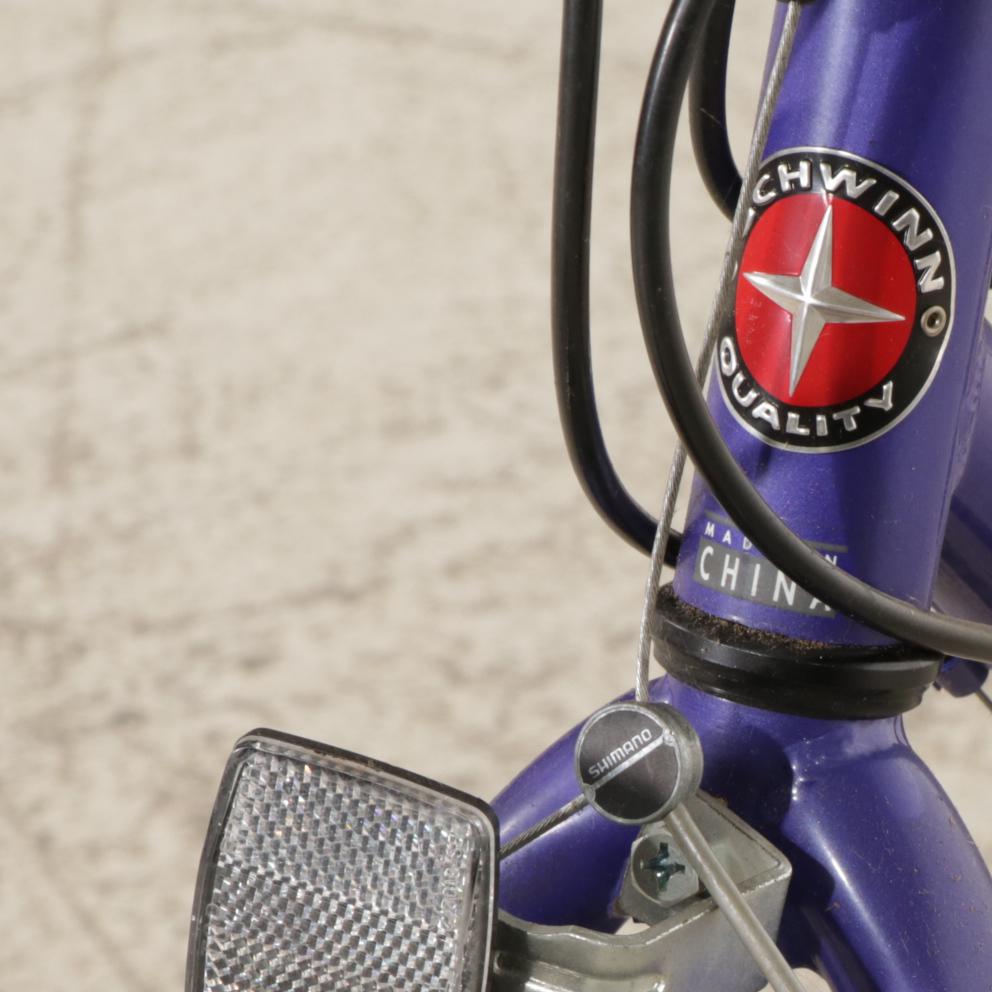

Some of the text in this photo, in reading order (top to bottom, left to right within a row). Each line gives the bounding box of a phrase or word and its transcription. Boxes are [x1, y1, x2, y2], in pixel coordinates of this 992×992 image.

[742, 160, 945, 294] CHWINN
[720, 335, 893, 437] QUALITY
[704, 521, 753, 551] MAD
[588, 728, 652, 778] SHIMANO
